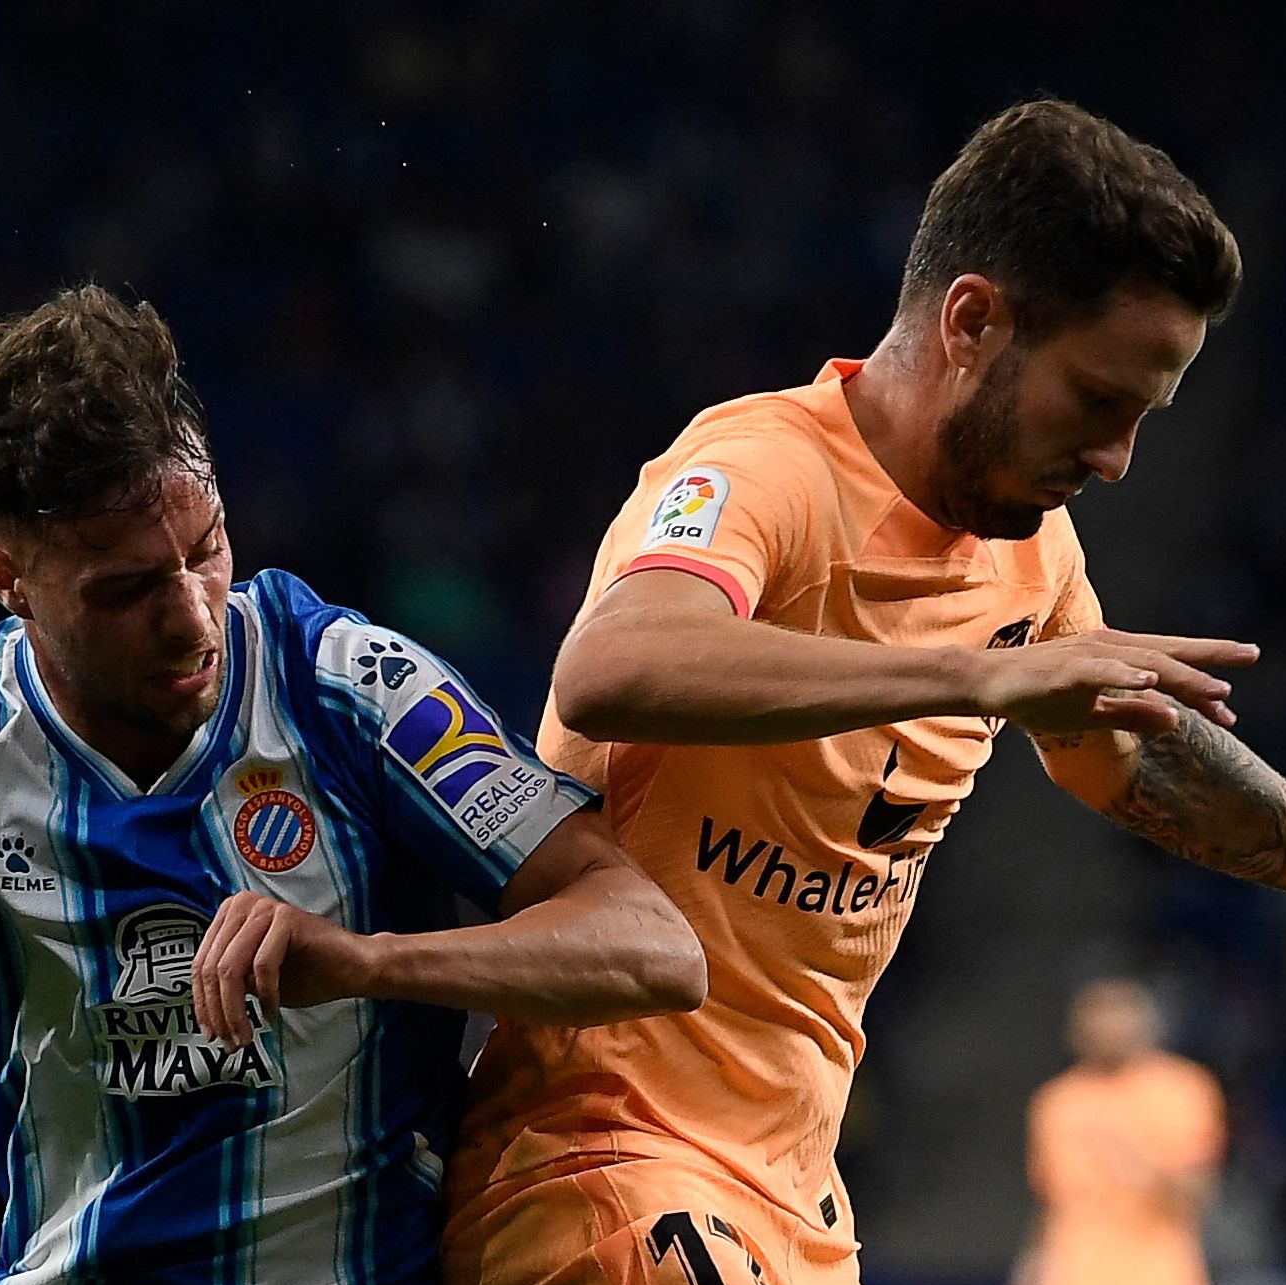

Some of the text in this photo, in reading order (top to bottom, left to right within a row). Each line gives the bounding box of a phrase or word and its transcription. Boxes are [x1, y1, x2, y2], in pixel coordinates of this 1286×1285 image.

[247, 792, 307, 817] ESPANYOL
[460, 766, 536, 830] REALE
[476, 778, 548, 843] SEGUROS
[259, 823, 314, 870] BARCELONA
[107, 1038, 272, 1096] MAYA
